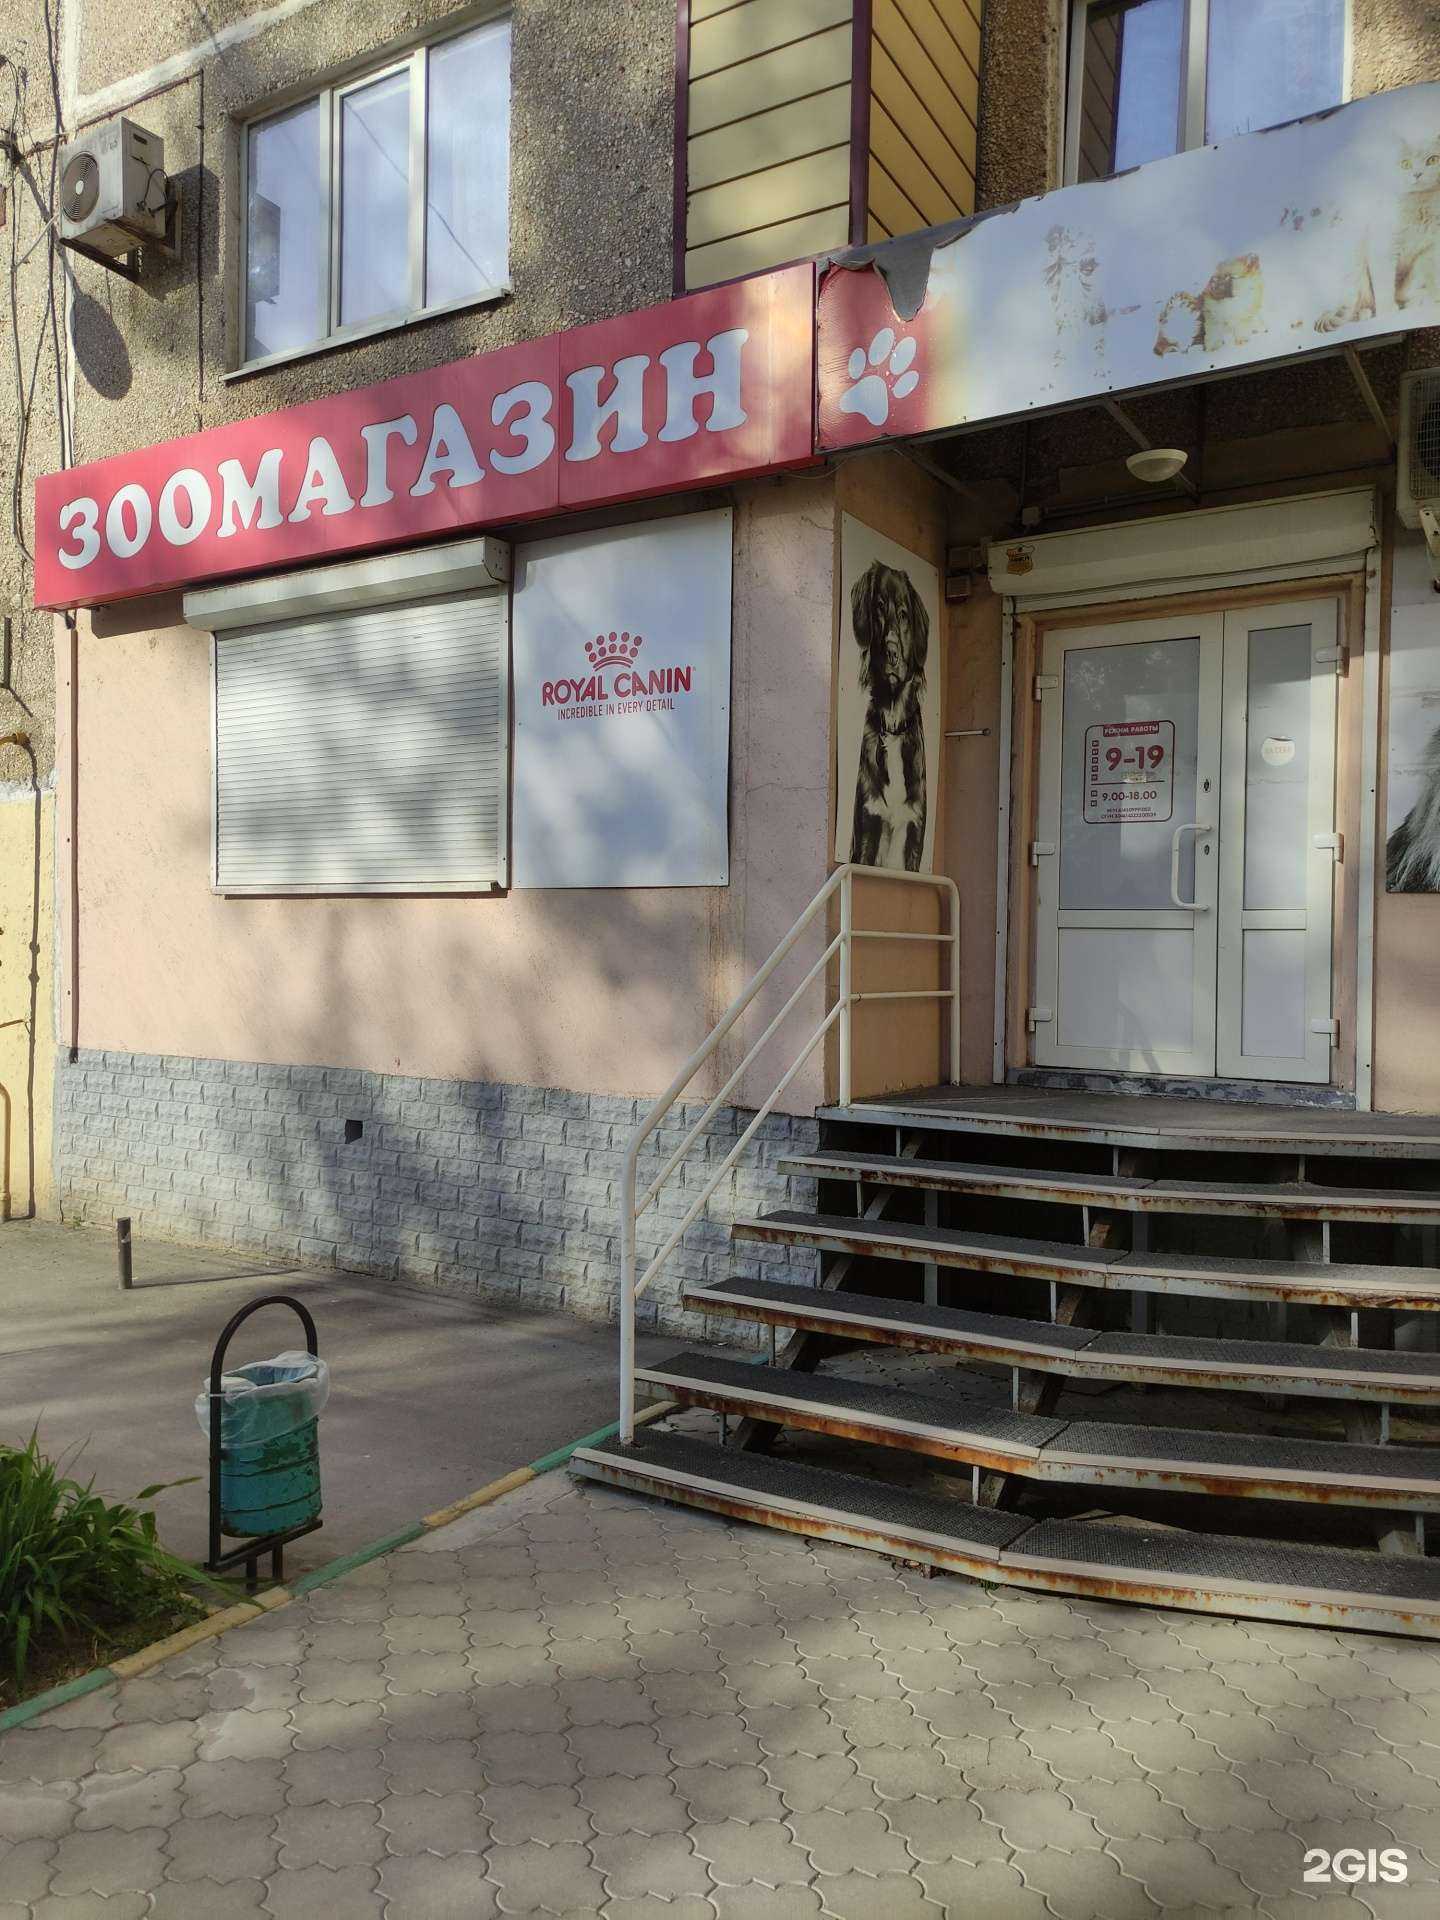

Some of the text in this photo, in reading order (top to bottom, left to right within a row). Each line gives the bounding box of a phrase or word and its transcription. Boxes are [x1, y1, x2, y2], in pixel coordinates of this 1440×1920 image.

[57, 327, 750, 570] ЗООМАГАЗИН
[542, 665, 692, 706] ROYAL CANIN
[558, 698, 676, 720] INCREDIBLE IN EVERY DETAIL
[1105, 744, 1165, 772] 9-19
[1102, 790, 1158, 801] 9.00-18.00
